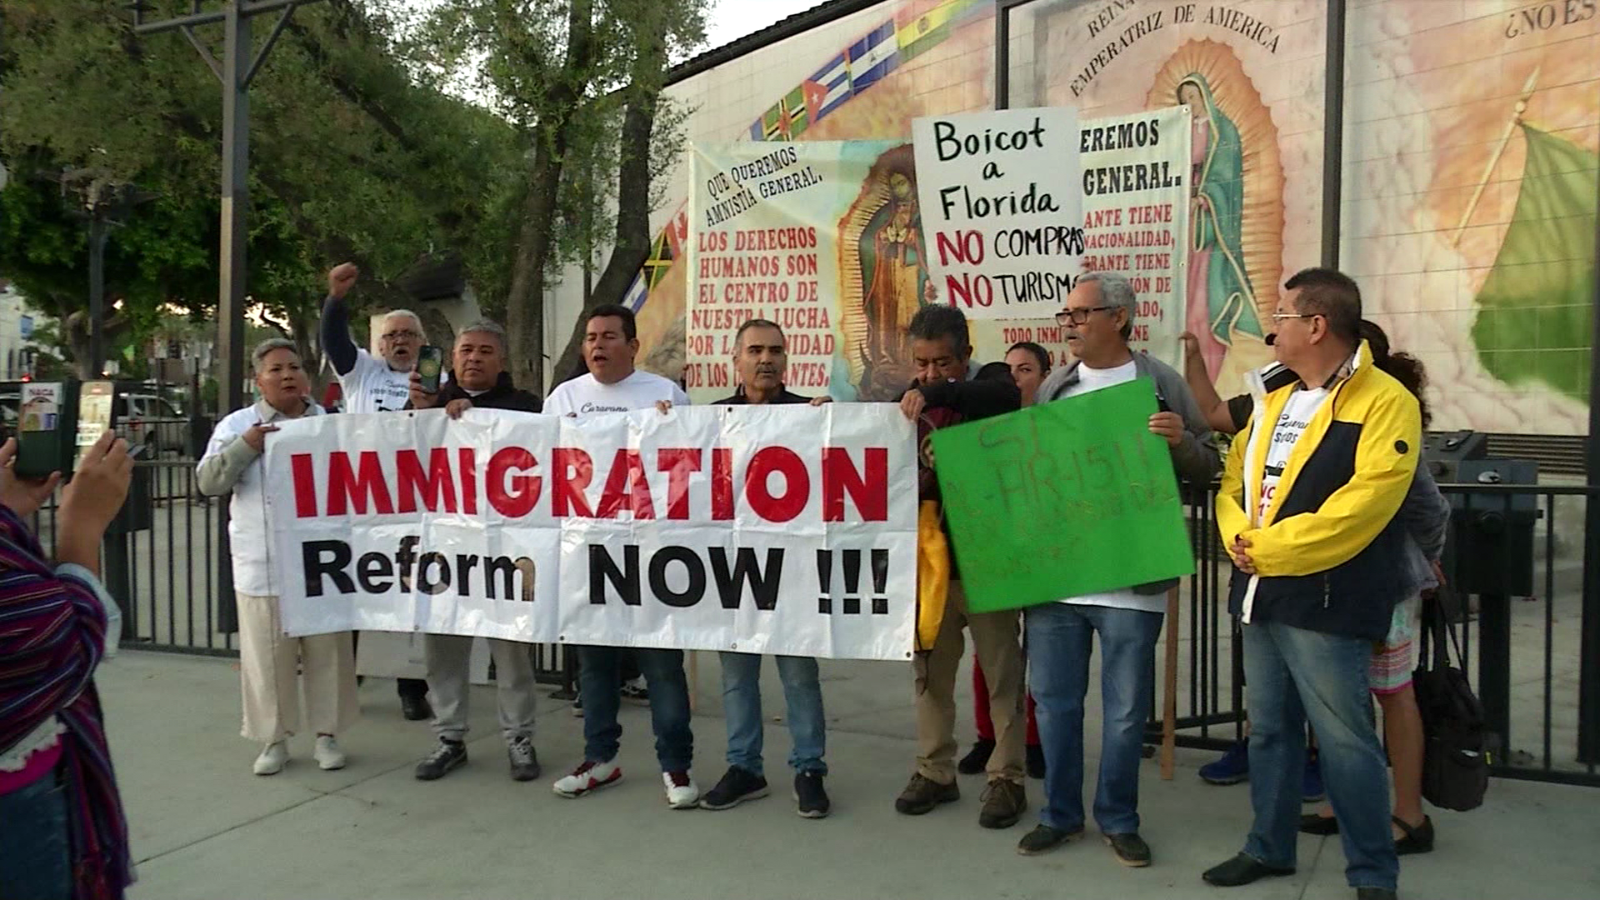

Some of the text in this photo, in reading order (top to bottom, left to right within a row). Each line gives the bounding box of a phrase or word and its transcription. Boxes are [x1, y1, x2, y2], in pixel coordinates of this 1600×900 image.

[1069, 4, 1282, 97] EMPERATRIZ DE AMERICA
[934, 117, 1045, 161] Boicot
[707, 146, 797, 200] QUE QUEREMOS
[983, 161, 1005, 180] a
[1083, 161, 1182, 196] GENERAL.
[705, 166, 823, 227] AMNISTIA GENERAL.
[940, 182, 1060, 220] Florida
[1128, 204, 1172, 225] TIENE
[698, 226, 817, 252] LOS DERECHOS
[936, 226, 1084, 266] NO COMPRAS
[699, 253, 817, 278] HUMANOS SON
[1135, 253, 1171, 270] TIENE
[698, 281, 818, 304] EL CENTRO DE
[946, 272, 993, 308] NO
[1155, 277, 1171, 293] DE
[774, 307, 830, 329] LUCHA
[1003, 327, 1032, 343] TODO
[687, 363, 702, 387] DE
[707, 362, 728, 387] LOS
[290, 445, 888, 523] IMMIGRATION
[302, 535, 536, 602] Reform
[588, 543, 786, 611] NOW
[816, 549, 889, 615] !!!
